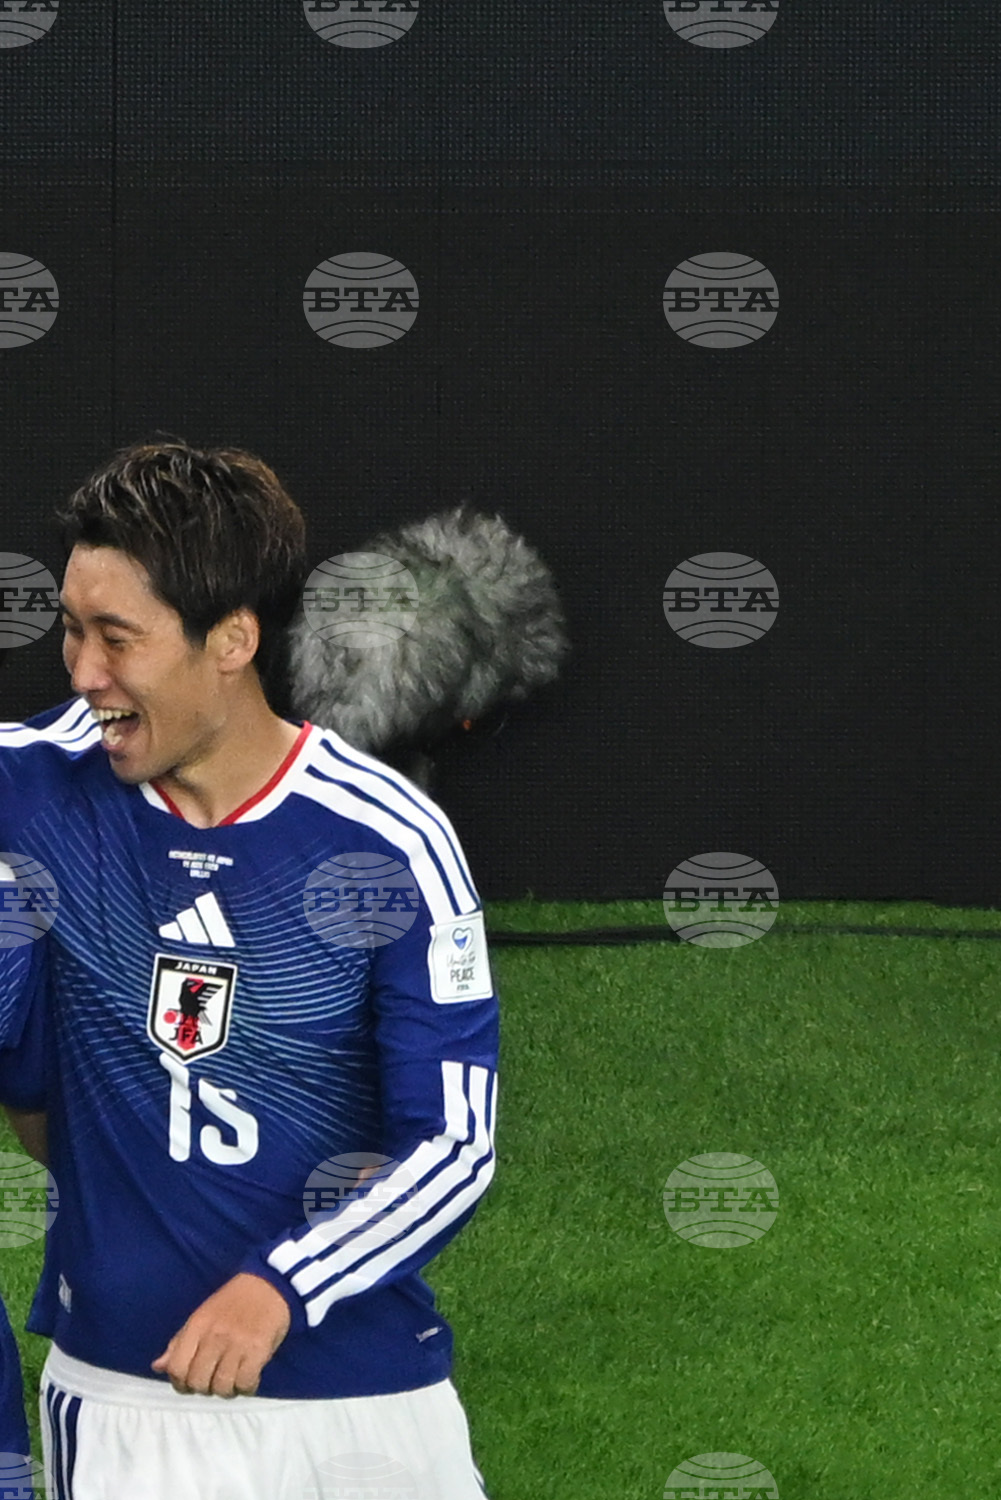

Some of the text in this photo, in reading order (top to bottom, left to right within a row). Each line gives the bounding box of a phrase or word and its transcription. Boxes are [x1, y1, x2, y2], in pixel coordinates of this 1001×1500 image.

[175, 961, 218, 975] JAPAN
[169, 1027, 203, 1045] JFA
[159, 1052, 259, 1165] 15
